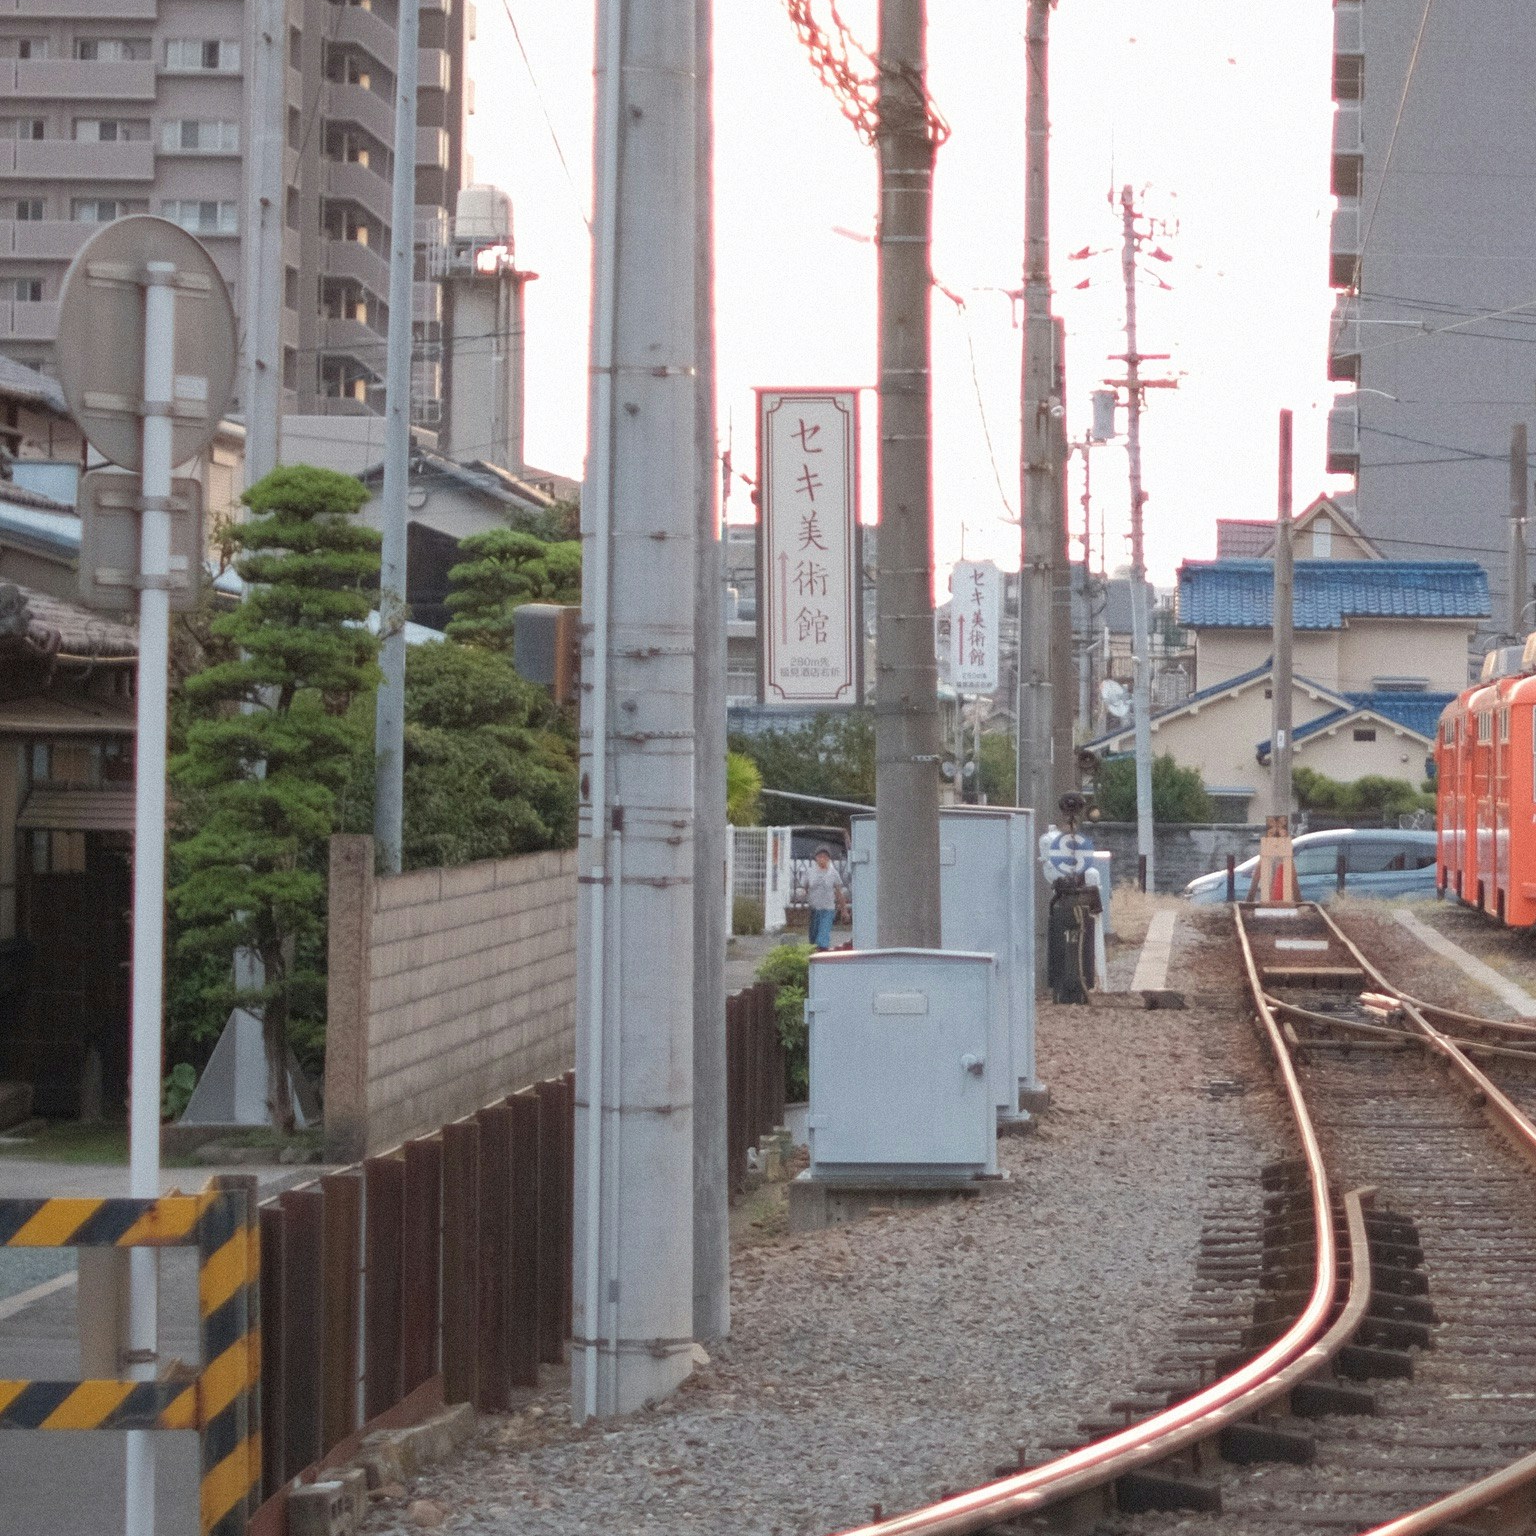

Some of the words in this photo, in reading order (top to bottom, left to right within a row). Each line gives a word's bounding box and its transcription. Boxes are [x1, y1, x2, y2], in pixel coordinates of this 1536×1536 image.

[790, 417, 830, 645] セキ美術館
[968, 568, 986, 667] セキ美術館
